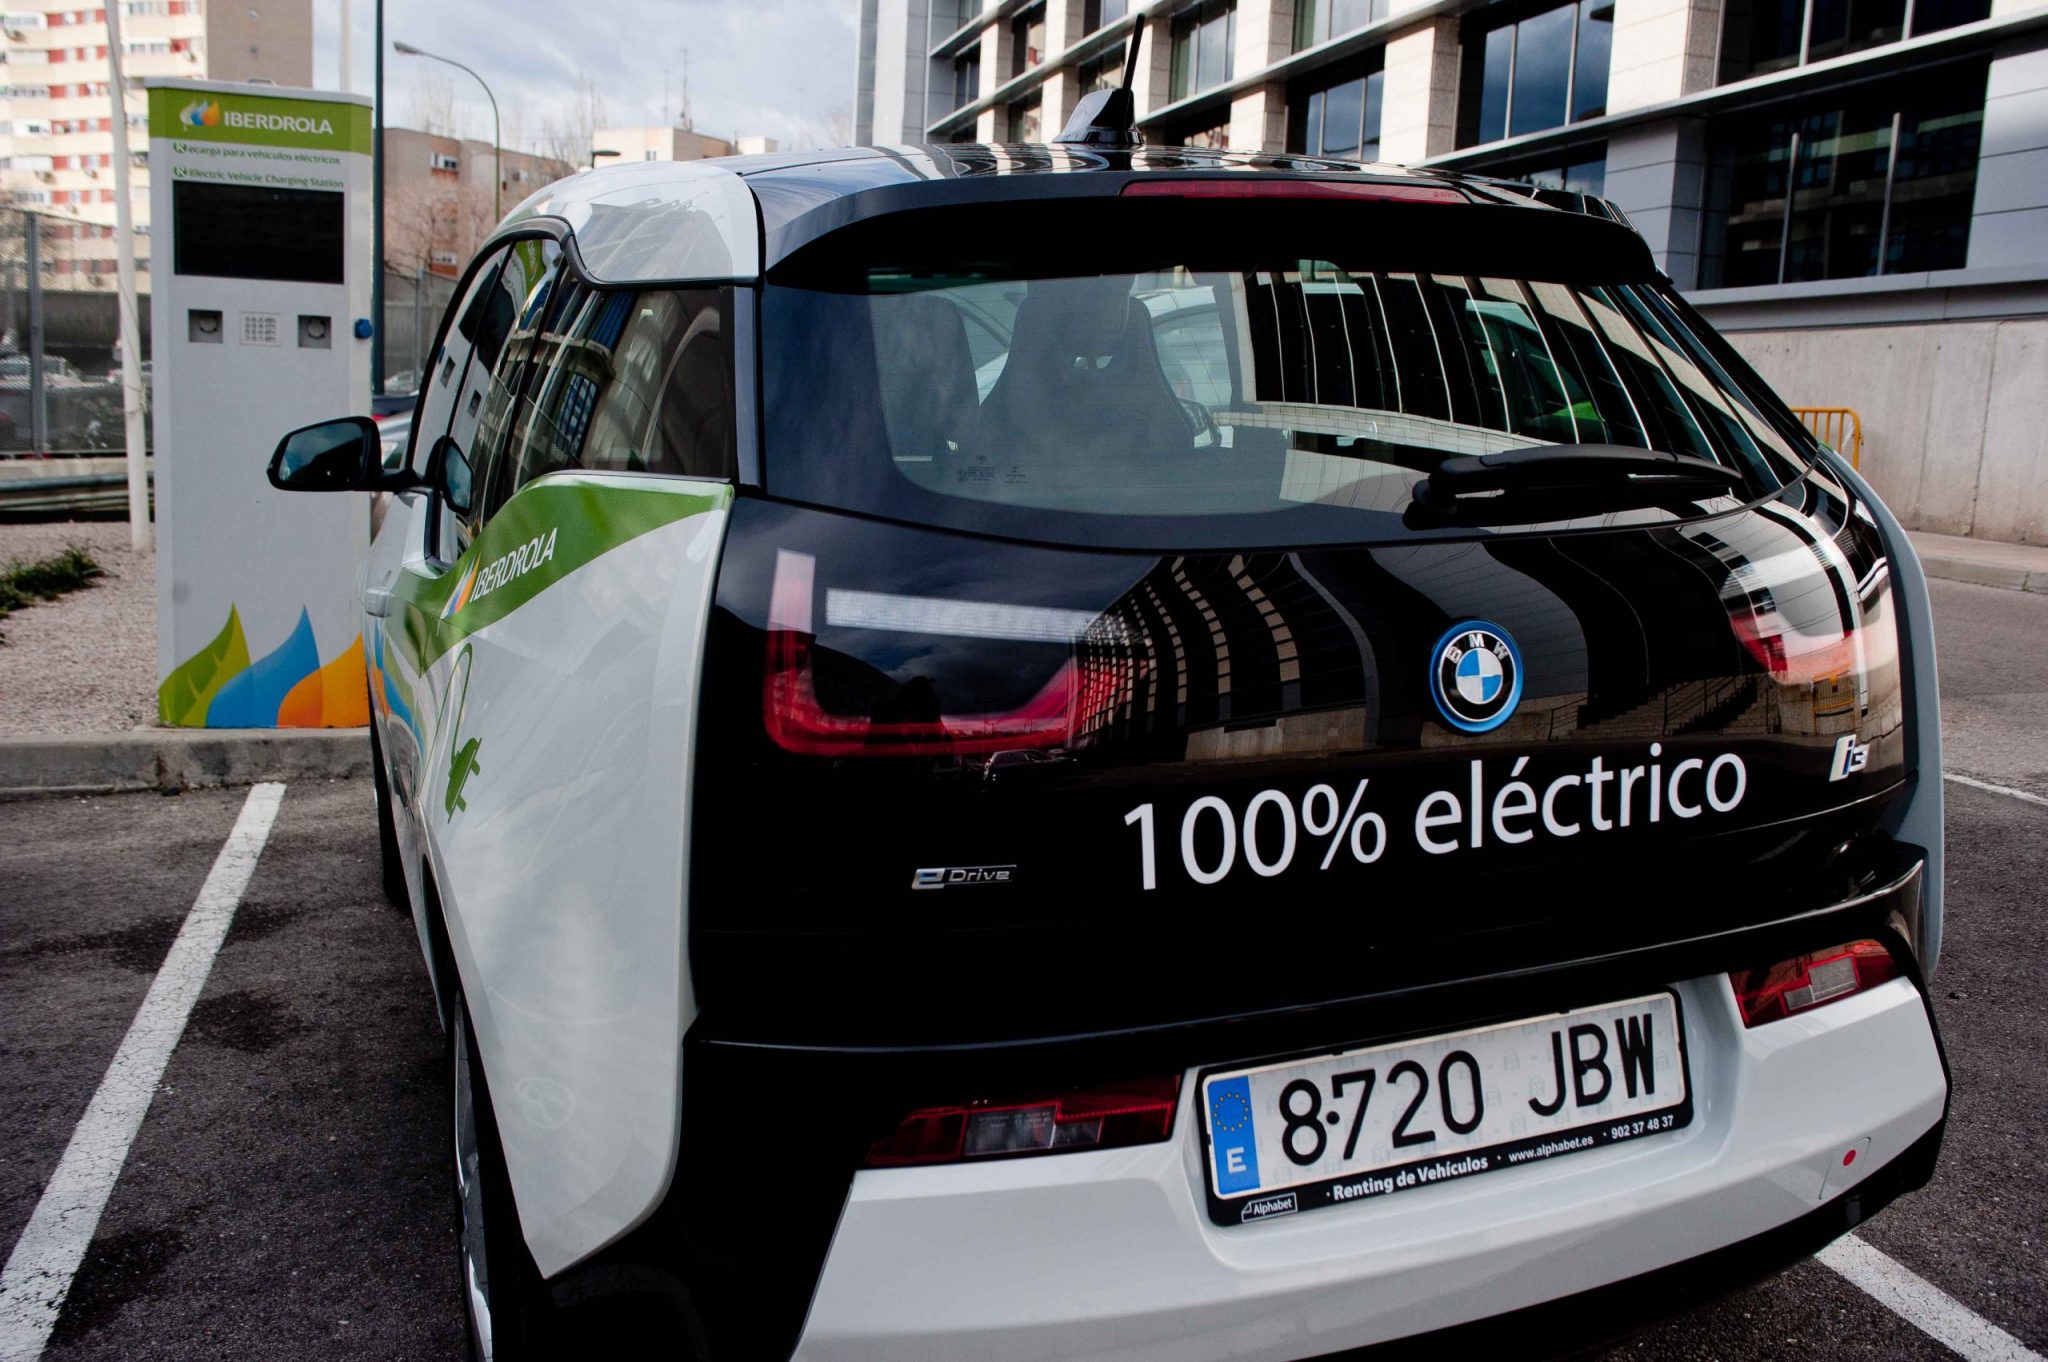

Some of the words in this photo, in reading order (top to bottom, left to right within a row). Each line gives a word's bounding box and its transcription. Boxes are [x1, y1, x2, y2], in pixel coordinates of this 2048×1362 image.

[223, 110, 334, 135] IBERDROLA
[223, 147, 246, 158] para
[189, 168, 226, 181] Electric
[227, 170, 263, 183] Vehicle
[264, 174, 310, 187] Charging
[310, 176, 344, 188] Station
[469, 527, 558, 604] IBERDROLA
[1445, 633, 1510, 664] BMW
[1828, 733, 1871, 783] i3
[1123, 778, 1388, 891] 100%
[1414, 742, 1748, 855] eléctrico
[1226, 1146, 1247, 1174] E
[1528, 1012, 1656, 1117] JBW
[1333, 1176, 1394, 1201] Renting
[1396, 1168, 1416, 1187] de
[1416, 1156, 1489, 1183] Vehículos
[1508, 1134, 1594, 1163] www.alphabet.es
[1611, 1125, 1631, 1140] 902
[1632, 1121, 1645, 1135] 37
[1646, 1117, 1660, 1131] 48
[1661, 1114, 1675, 1128] 37
[1253, 1198, 1293, 1216] Alphabet
